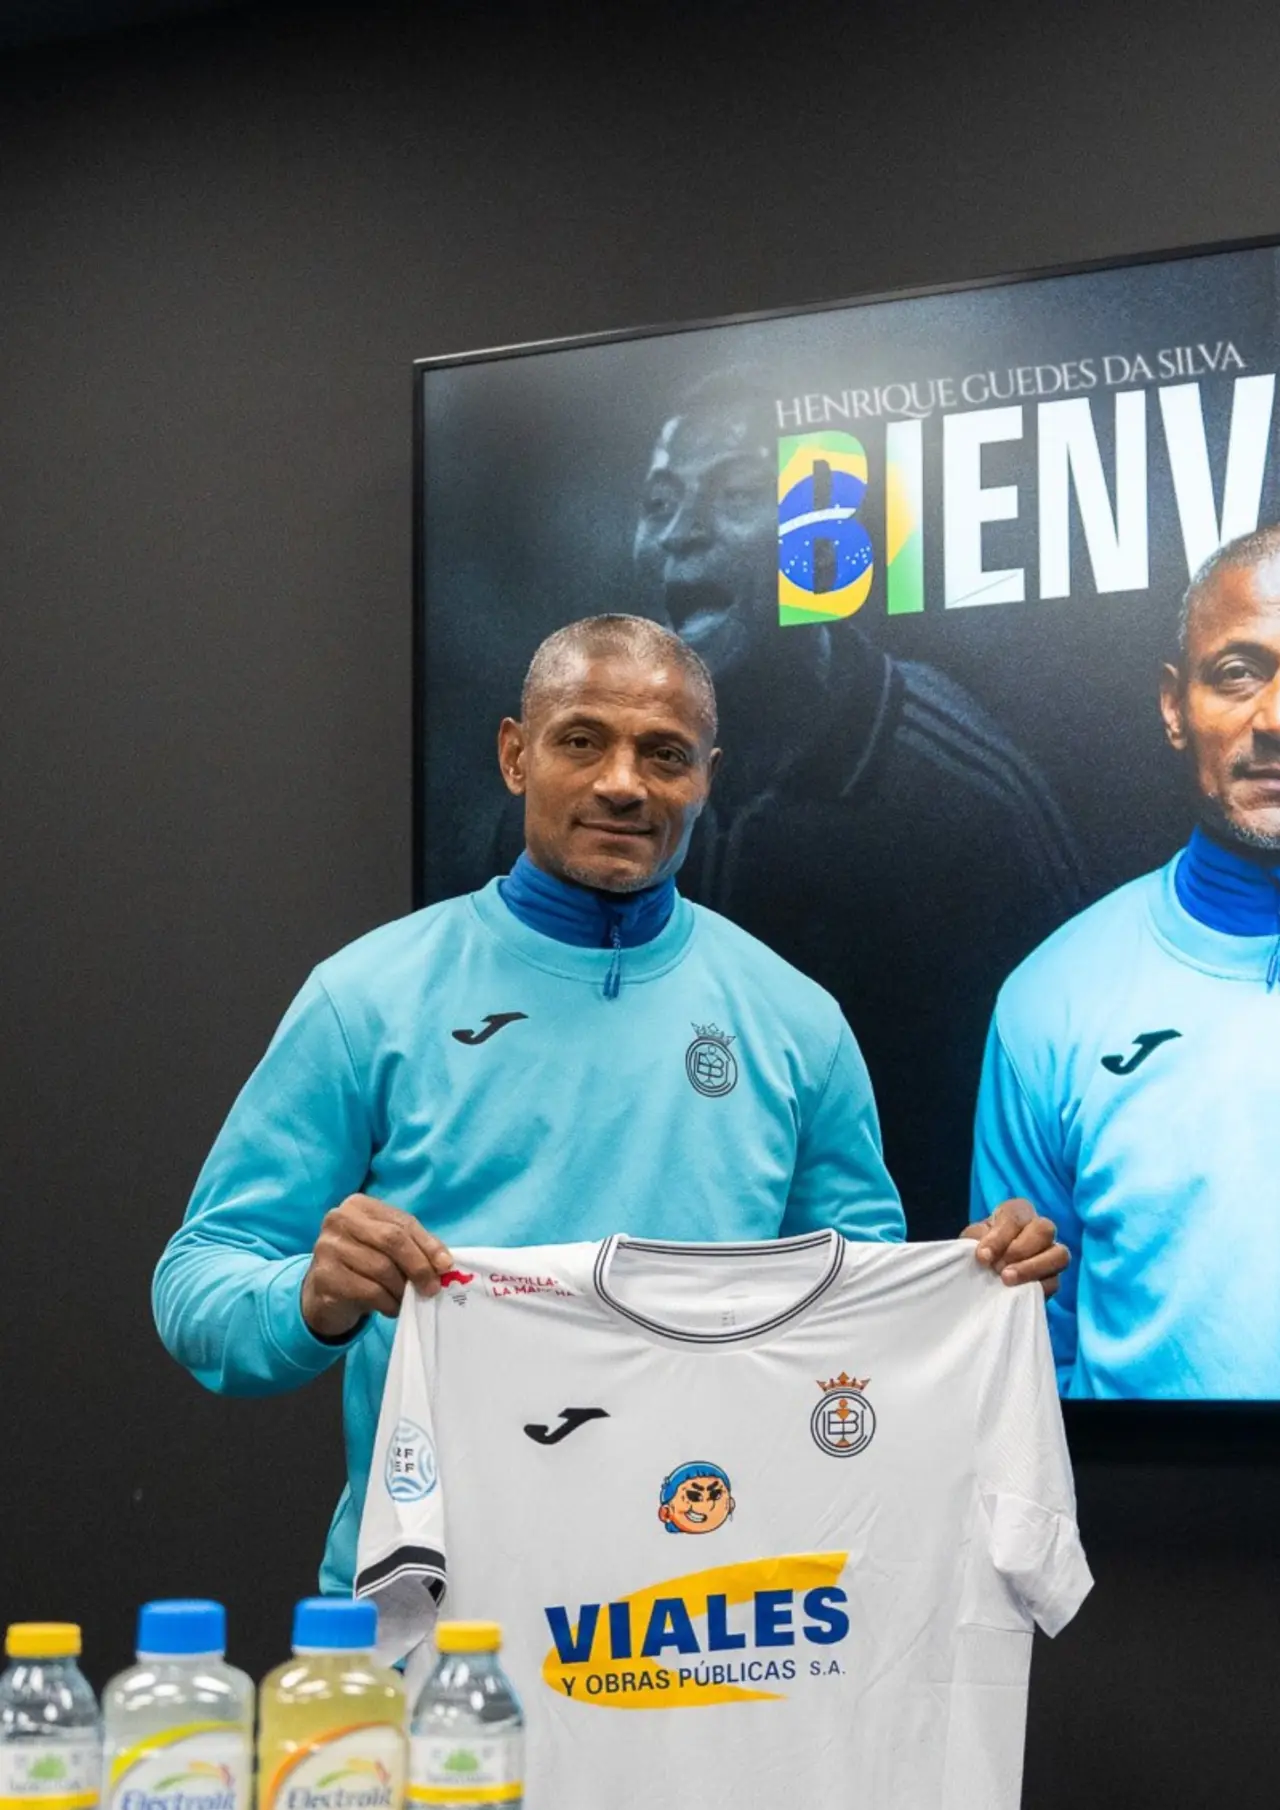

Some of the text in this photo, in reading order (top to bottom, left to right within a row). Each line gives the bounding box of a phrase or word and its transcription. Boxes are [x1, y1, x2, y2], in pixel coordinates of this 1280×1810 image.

[776, 341, 1248, 429] HENRIQUE GUEDES DA SILVA
[544, 1586, 850, 1664] VIALES
[561, 1659, 846, 1697] Y OBRAS PÚBLICAS S.A.
